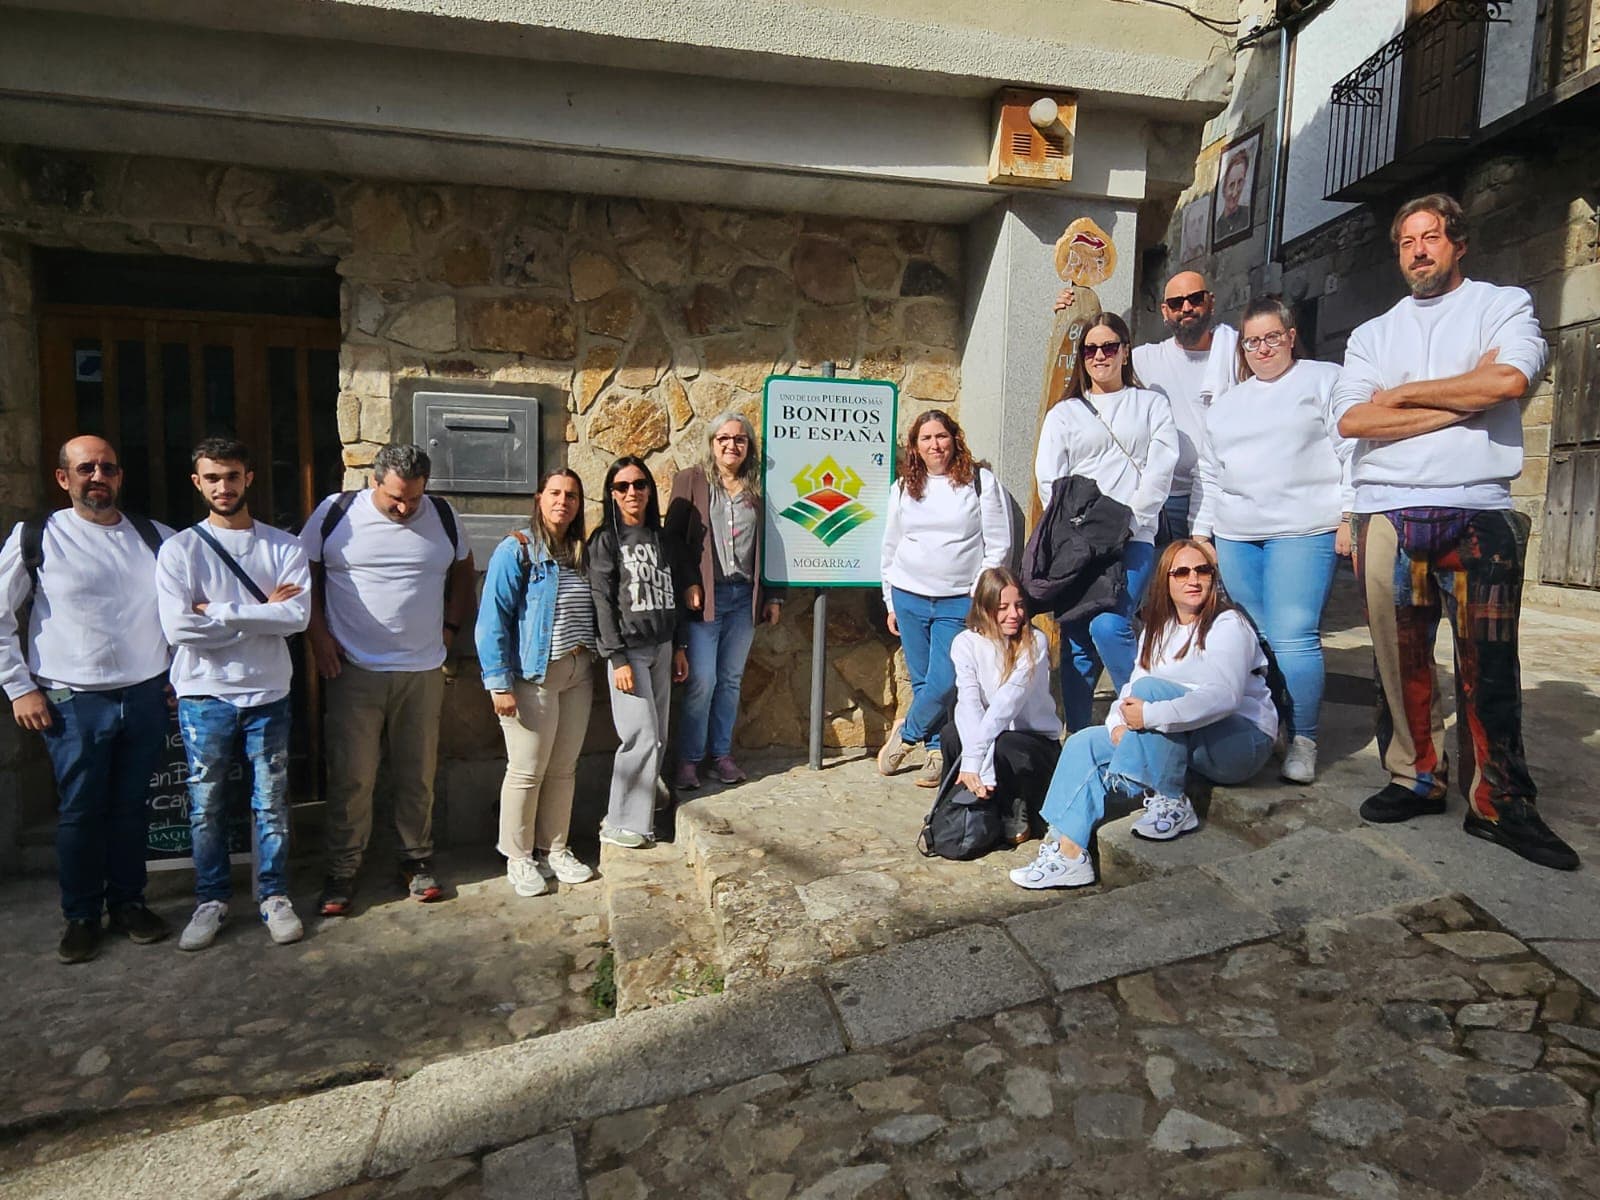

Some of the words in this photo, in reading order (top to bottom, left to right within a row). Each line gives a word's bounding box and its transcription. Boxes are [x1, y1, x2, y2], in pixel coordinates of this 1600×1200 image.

[796, 394, 806, 402] DE
[807, 395, 820, 403] LOS
[822, 394, 867, 405] PUEBLOS
[783, 405, 880, 425] BONITOS
[774, 425, 801, 439] DE
[808, 426, 886, 443] ESPAÑA
[793, 558, 861, 569] MOGARRAZ
